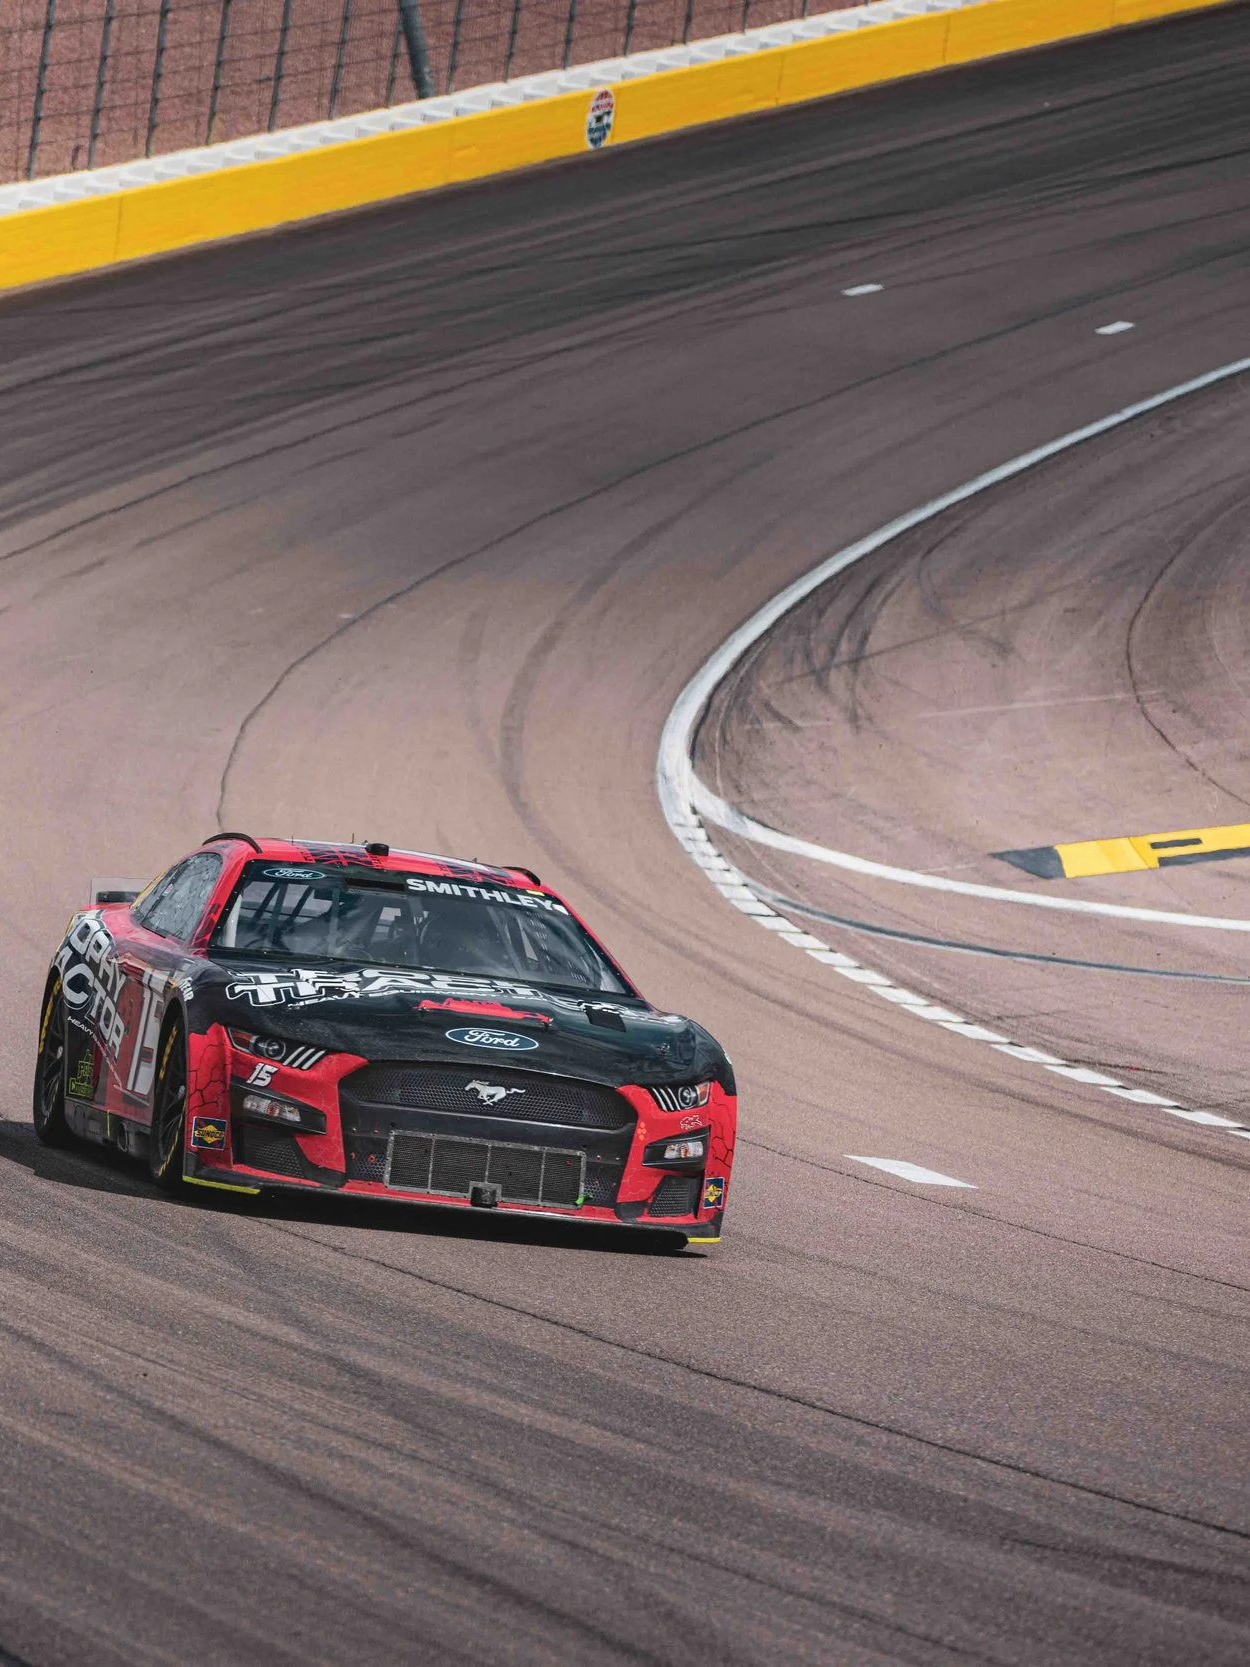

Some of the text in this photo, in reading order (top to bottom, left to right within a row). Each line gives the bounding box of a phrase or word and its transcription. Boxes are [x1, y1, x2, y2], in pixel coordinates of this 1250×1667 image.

[406, 878, 554, 911] SMITHLEY
[67, 1016, 94, 1036] HEAVY
[246, 1063, 279, 1087] 15
